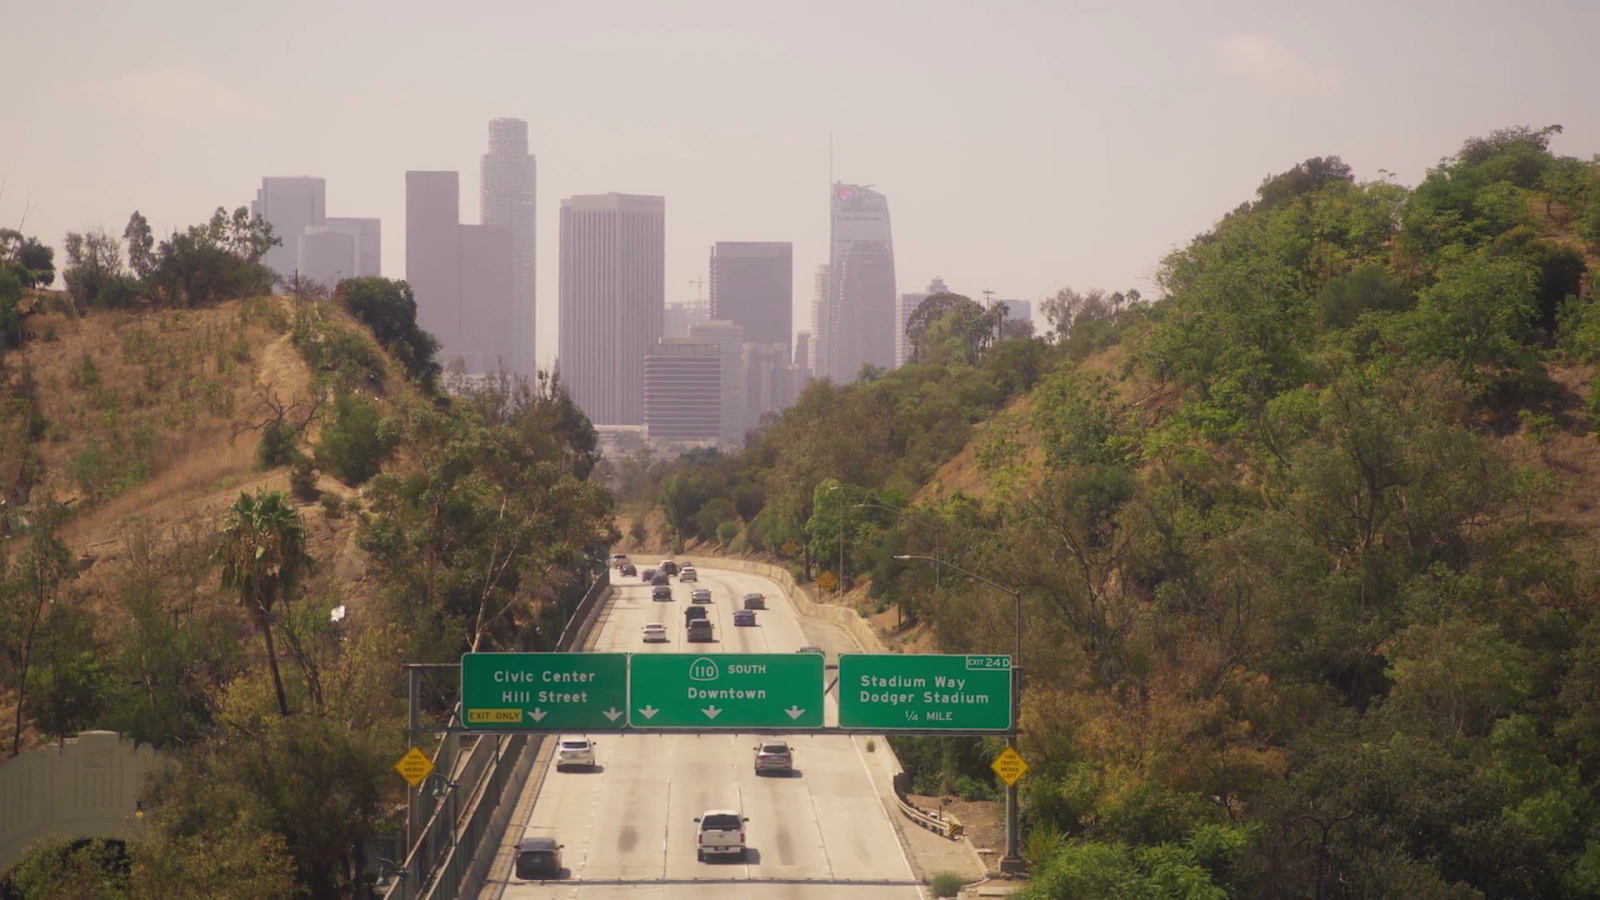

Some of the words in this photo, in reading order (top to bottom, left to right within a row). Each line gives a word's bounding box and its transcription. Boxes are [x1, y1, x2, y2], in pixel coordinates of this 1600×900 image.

[967, 658, 984, 667] EXIT
[695, 666, 714, 677] 110
[728, 664, 766, 674] SOUTH
[494, 670, 534, 682] Civic
[542, 670, 595, 682] Center
[860, 675, 926, 687] Stadium
[934, 676, 965, 690] Way
[502, 691, 530, 703] Hill
[538, 691, 588, 703] Street
[687, 687, 766, 699] Downtown
[860, 691, 914, 705] Dodger
[923, 691, 989, 704] Stadium
[469, 711, 490, 720] EXIT
[496, 711, 521, 720] ONLY
[926, 711, 953, 721] MILE
